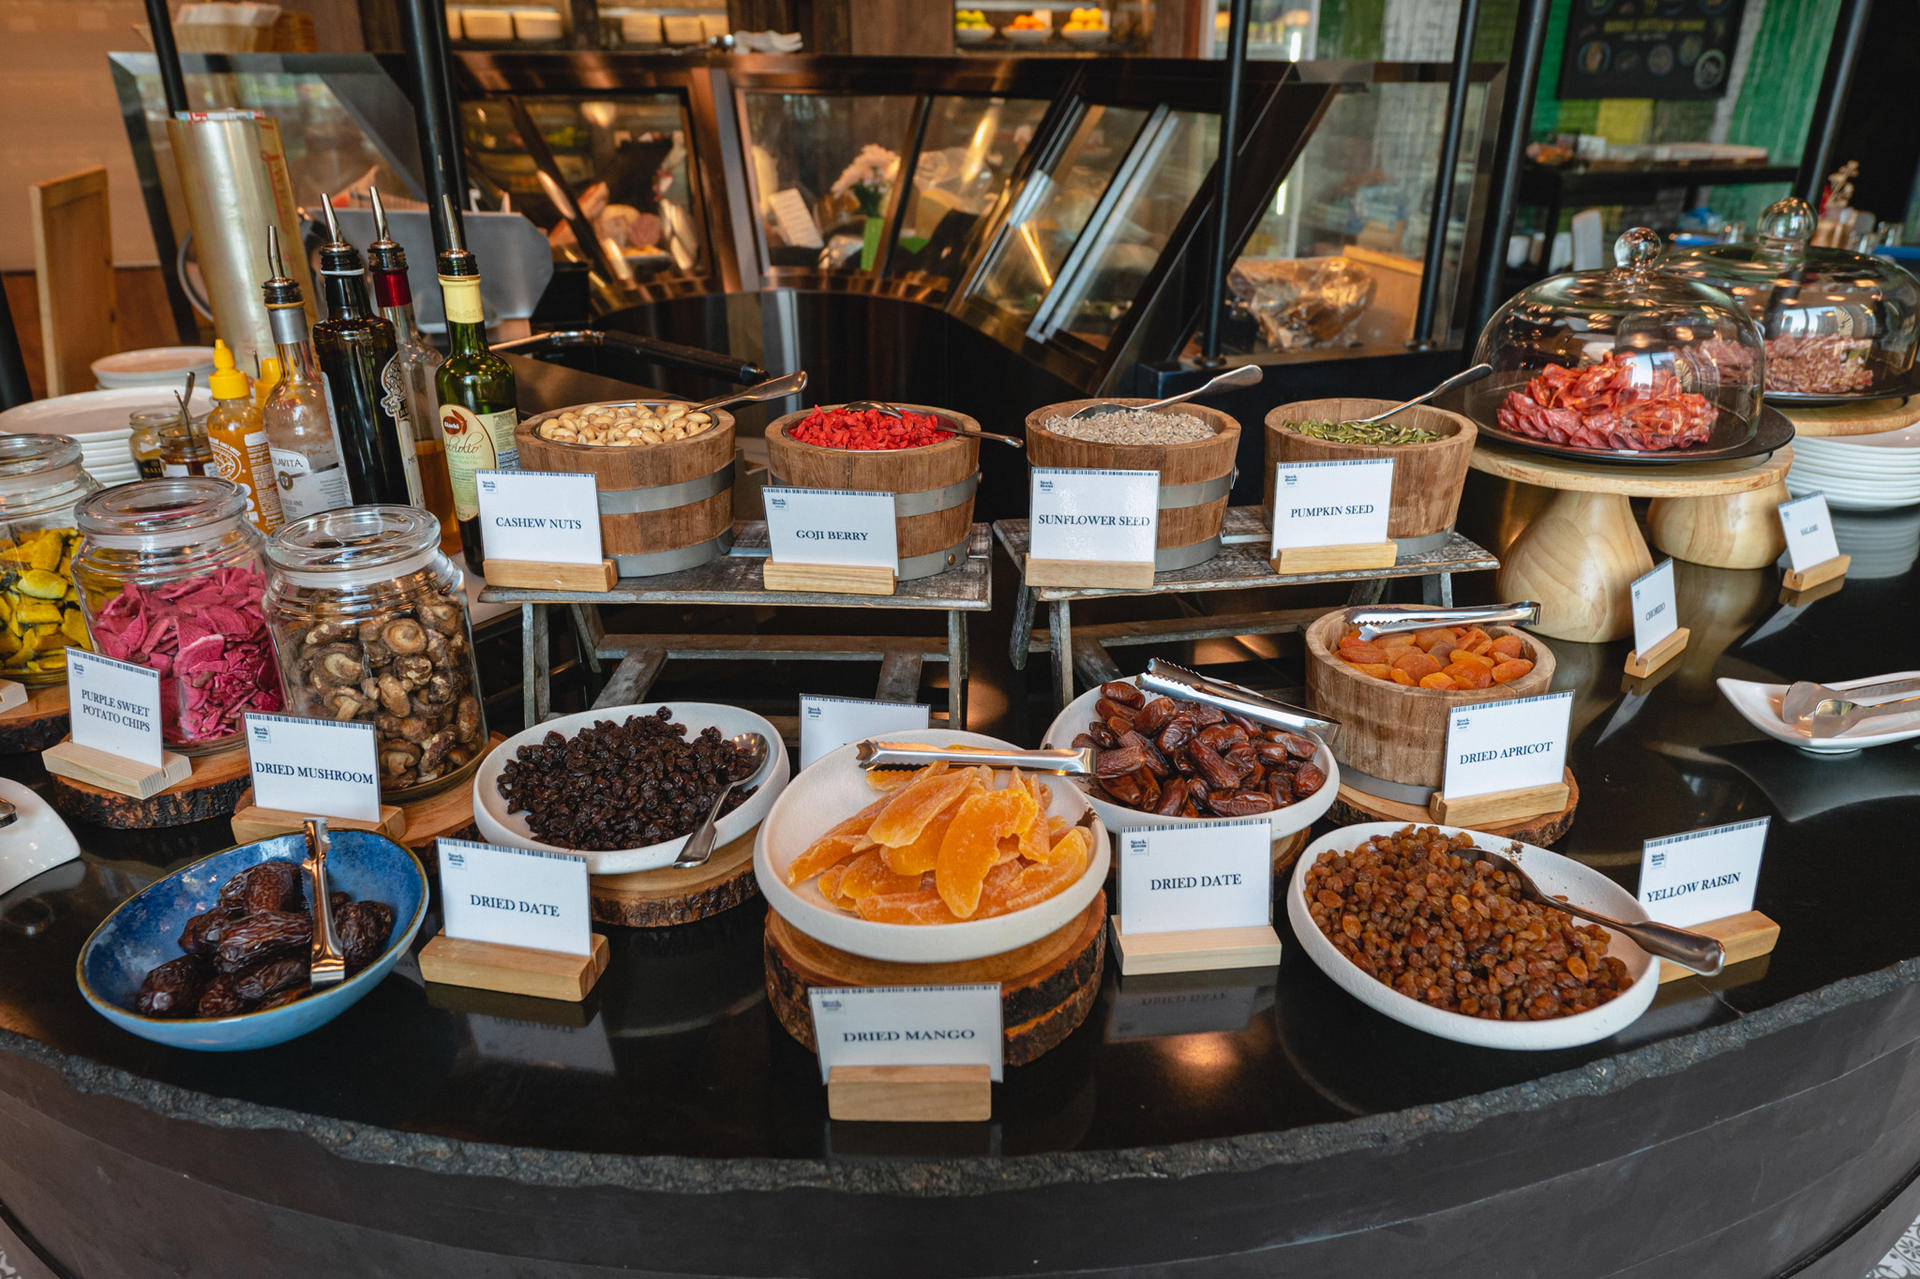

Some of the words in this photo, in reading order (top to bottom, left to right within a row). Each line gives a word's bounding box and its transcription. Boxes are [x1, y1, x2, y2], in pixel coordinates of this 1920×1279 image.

[1038, 514, 1116, 526] SUNFLOWER
[1118, 515, 1151, 526] SEED
[1290, 506, 1343, 518] PUMPKIN
[1345, 504, 1374, 515] SEED
[495, 516, 546, 528] CASHEW
[549, 519, 582, 529] NUTS
[796, 529, 825, 540] GOJI
[827, 530, 869, 541] BERRY
[81, 688, 116, 708] PURPLE
[117, 699, 150, 717] SWEET
[82, 703, 120, 723] POTATO
[122, 716, 151, 732] CHIPS
[1459, 750, 1498, 765] DRIED
[1500, 741, 1554, 759] APRICOT
[255, 761, 295, 776] DRIED
[297, 766, 374, 784] MUSHROOM
[1150, 876, 1197, 891] DRIED
[1201, 873, 1242, 888] DATE
[1646, 881, 1700, 902] YELLOW
[1701, 871, 1741, 891] RAISIN
[470, 894, 515, 911] DRIED
[518, 900, 560, 917] DATE
[843, 1031, 900, 1042] DRIED
[905, 1028, 975, 1041] MANGO
